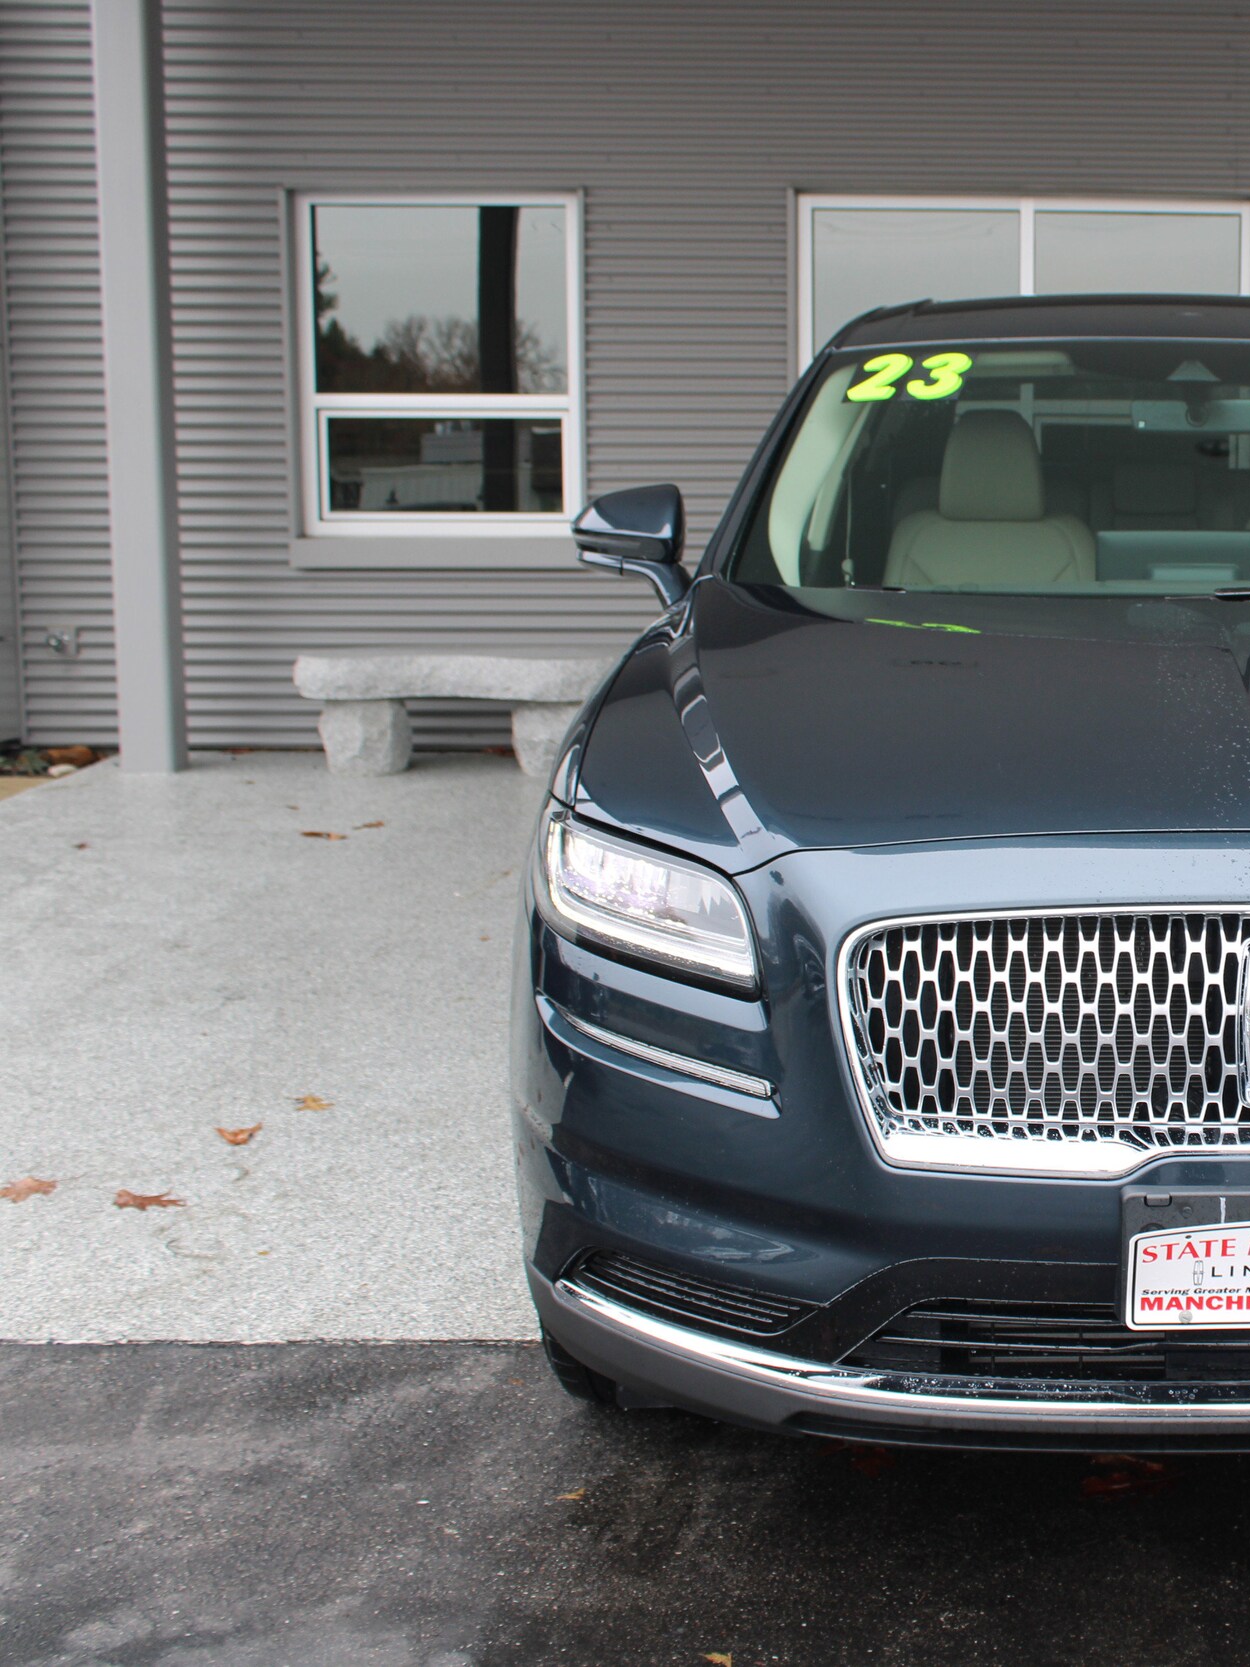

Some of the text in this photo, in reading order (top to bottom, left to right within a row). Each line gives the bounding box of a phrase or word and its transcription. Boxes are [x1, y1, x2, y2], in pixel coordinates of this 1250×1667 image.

[846, 352, 973, 402] 23
[1142, 1238, 1237, 1263] STATE
[1141, 1288, 1190, 1296] Serving
[1193, 1287, 1241, 1295] Greater
